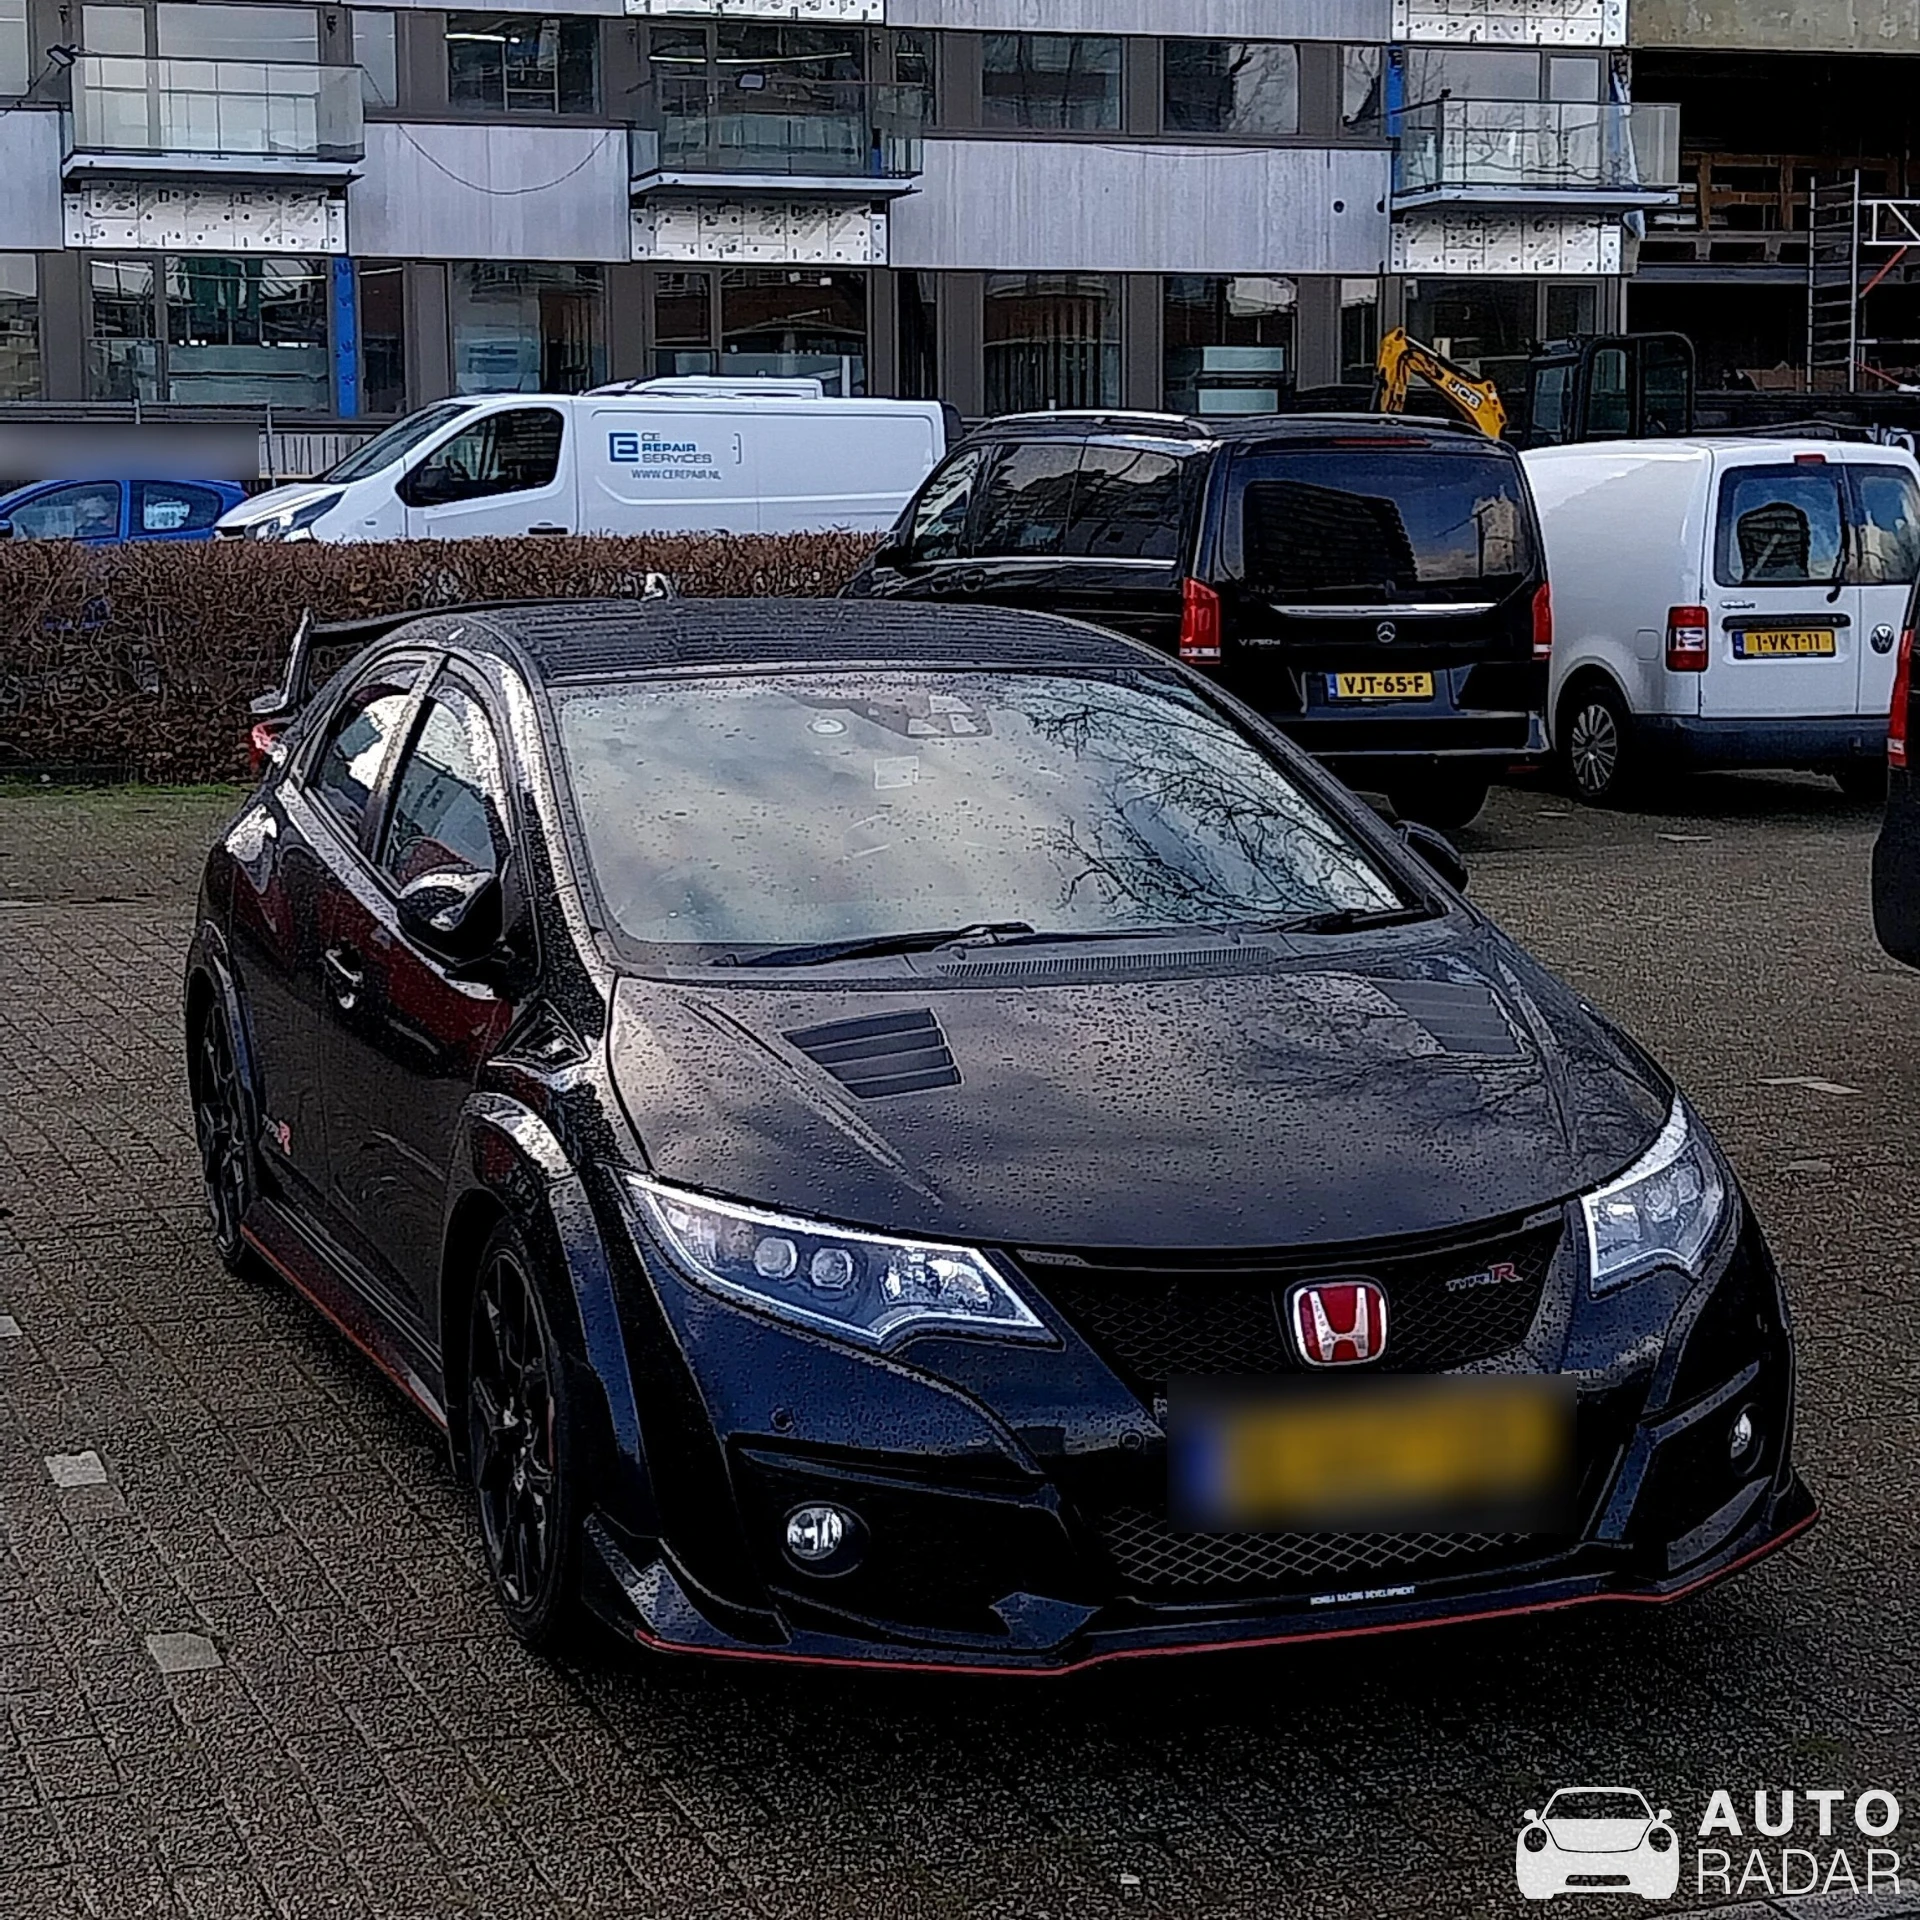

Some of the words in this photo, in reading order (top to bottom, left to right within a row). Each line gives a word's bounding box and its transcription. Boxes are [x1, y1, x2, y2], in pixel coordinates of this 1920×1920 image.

[1448, 381, 1480, 409] JCB
[641, 432, 661, 441] CE
[641, 443, 697, 452] REPAIR
[642, 453, 712, 464] SERVICES
[1755, 633, 1820, 651] 1-VKT-11
[1343, 676, 1425, 695] VJT-65-F
